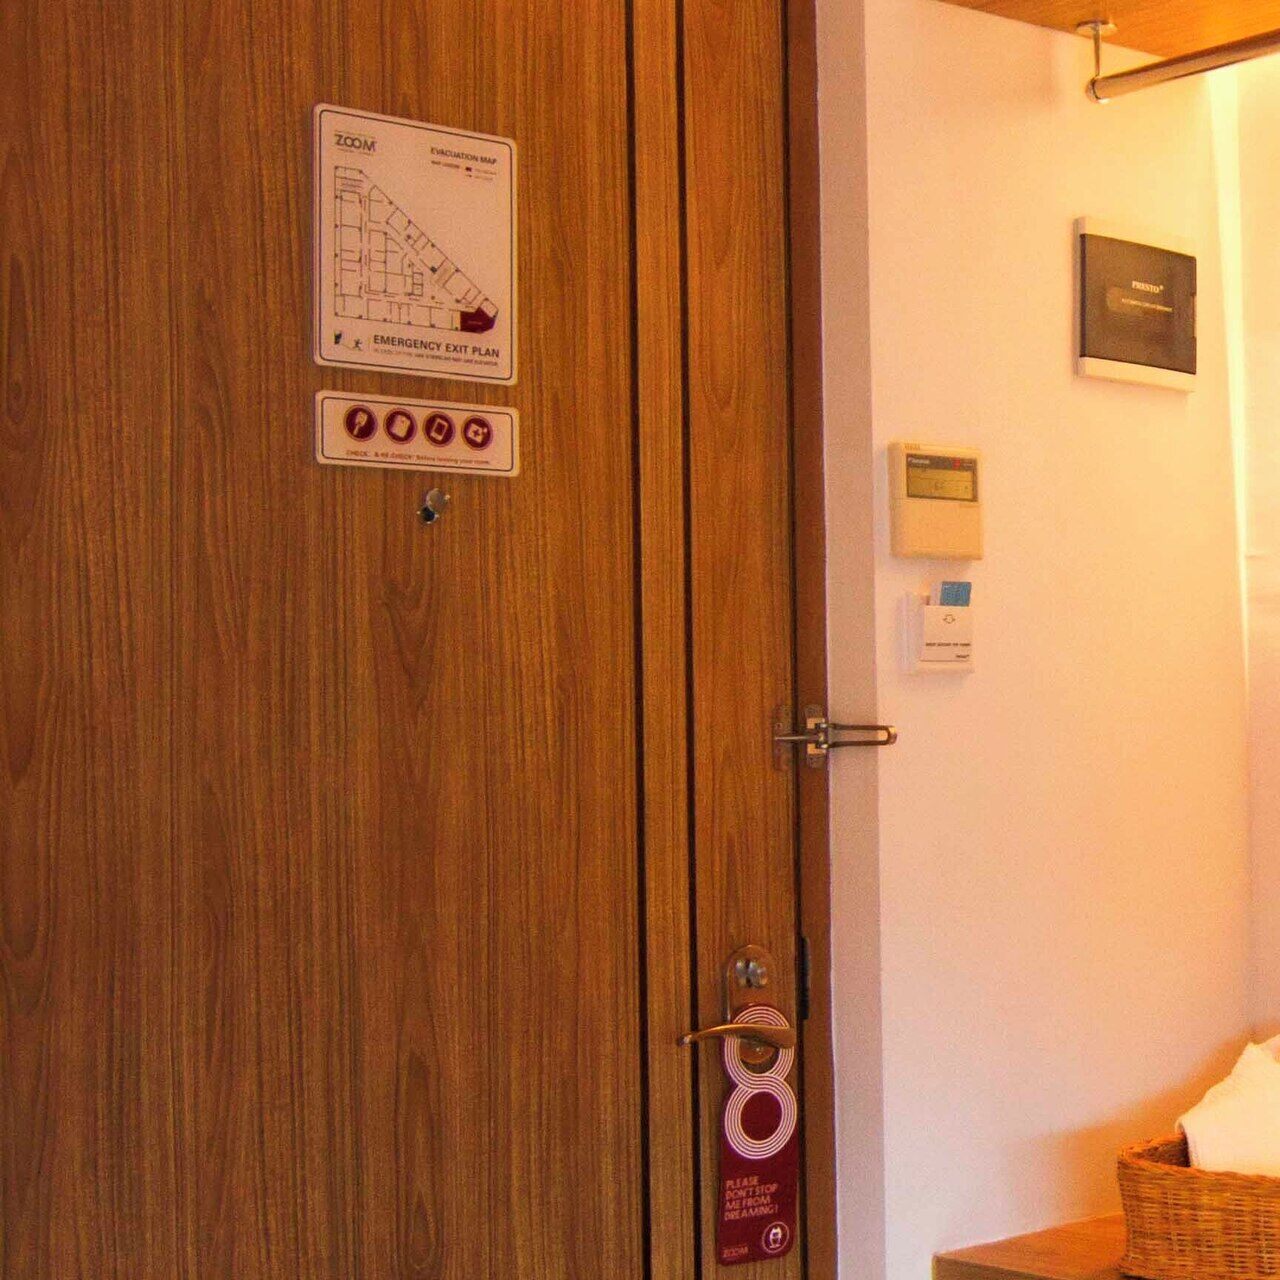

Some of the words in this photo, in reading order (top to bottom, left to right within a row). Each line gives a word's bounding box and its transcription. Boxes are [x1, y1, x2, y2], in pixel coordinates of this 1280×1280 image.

[333, 133, 376, 152] ZOOM
[431, 147, 479, 162] EVACUATION
[480, 156, 497, 165] MAP
[373, 334, 442, 351] EMERGENCY
[445, 342, 469, 354] EXIT
[472, 346, 500, 358] PLAN
[726, 1176, 759, 1189] PLEASE
[755, 1182, 778, 1196] STOP
[726, 1200, 741, 1210] ME
[742, 1195, 771, 1207] FROM
